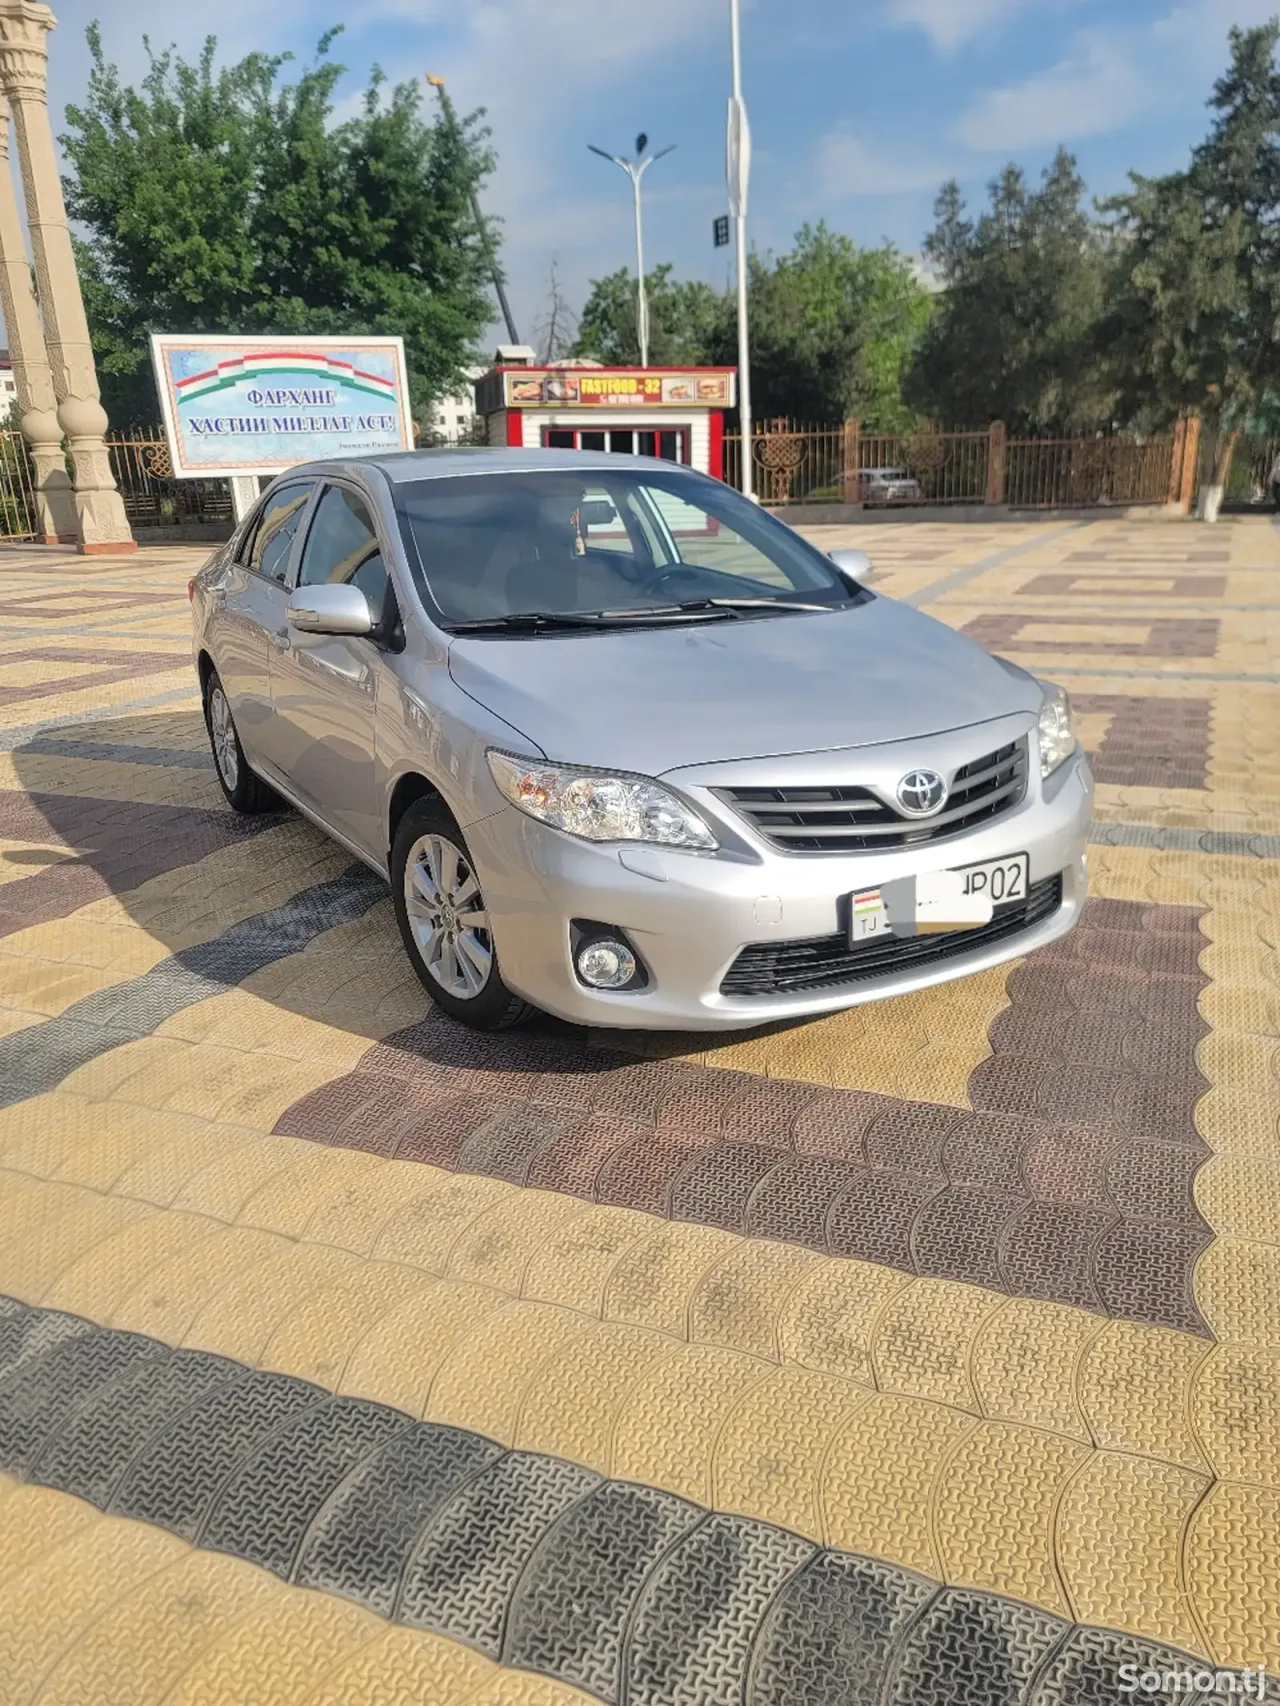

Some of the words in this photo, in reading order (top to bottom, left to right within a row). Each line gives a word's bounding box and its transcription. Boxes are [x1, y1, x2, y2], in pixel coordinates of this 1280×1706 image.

[272, 415, 350, 432] МИЛЛАТ
[356, 414, 394, 430] АСТ!
[860, 916, 877, 935] TJ
